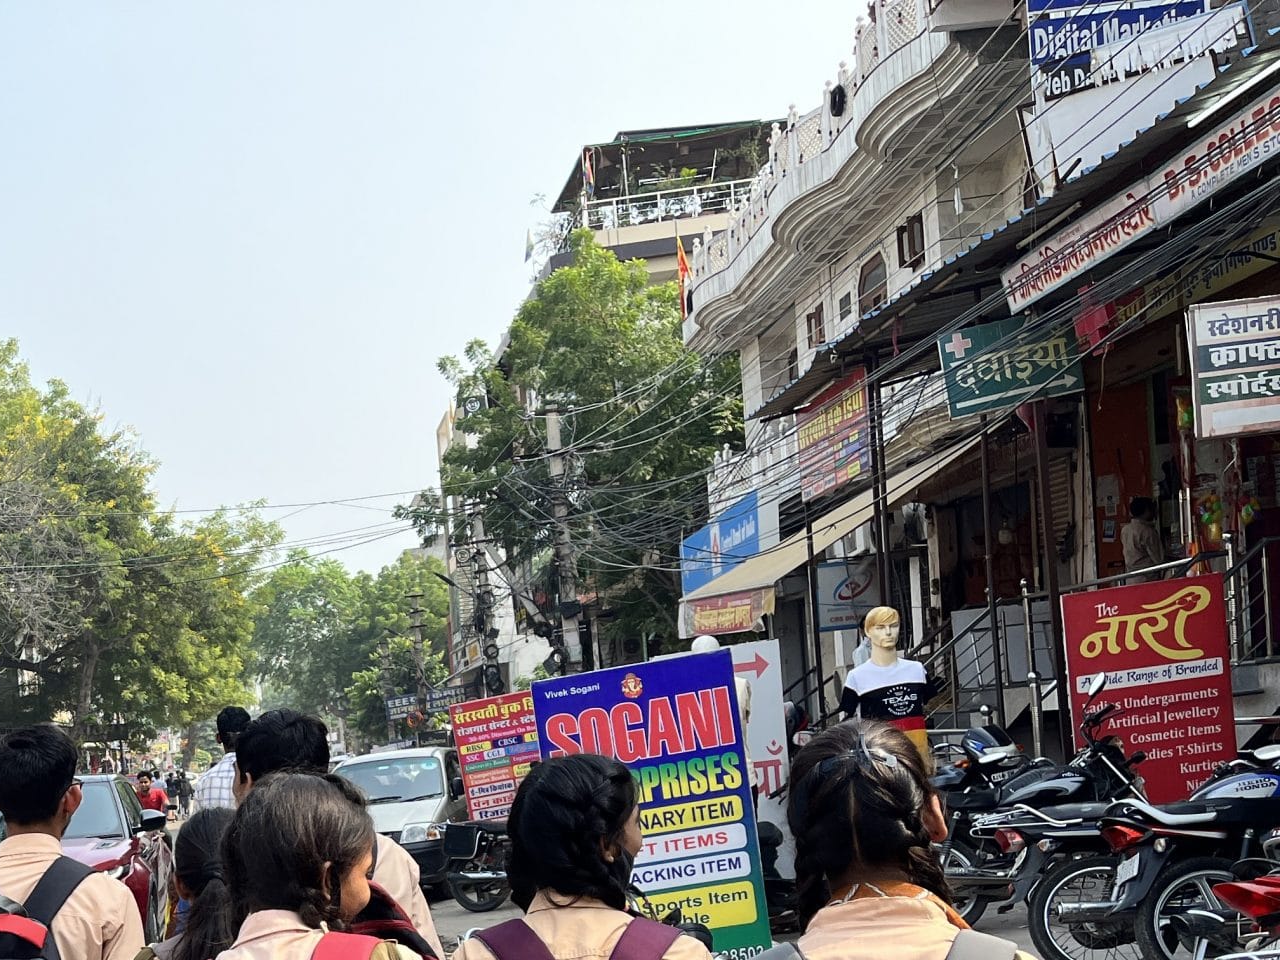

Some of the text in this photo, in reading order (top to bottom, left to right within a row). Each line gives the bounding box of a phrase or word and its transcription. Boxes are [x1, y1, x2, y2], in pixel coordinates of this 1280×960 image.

[1035, 20, 1098, 59] Digital
[1197, 162, 1235, 197] COMPLETE
[1094, 602, 1119, 618] The
[1079, 585, 1211, 660] नारी
[1126, 669, 1159, 684] Range
[1161, 664, 1173, 680] of
[1175, 659, 1219, 676] Branded
[544, 683, 600, 699] Vivek Sogani
[882, 693, 918, 705] TEXAS
[1124, 687, 1219, 710] Undergarments
[500, 700, 521, 719] बुक
[1107, 705, 1220, 730] Artificial Jewellery
[545, 685, 736, 764] SOGANI
[1130, 723, 1222, 745] Cosmetic Items
[1176, 741, 1223, 757] T-Shirts
[1235, 781, 1276, 792] HONDA
[692, 800, 735, 822] ITEM
[665, 832, 728, 853] ITEMS
[631, 857, 742, 885] ACKING ITEM
[709, 888, 748, 903] Item
